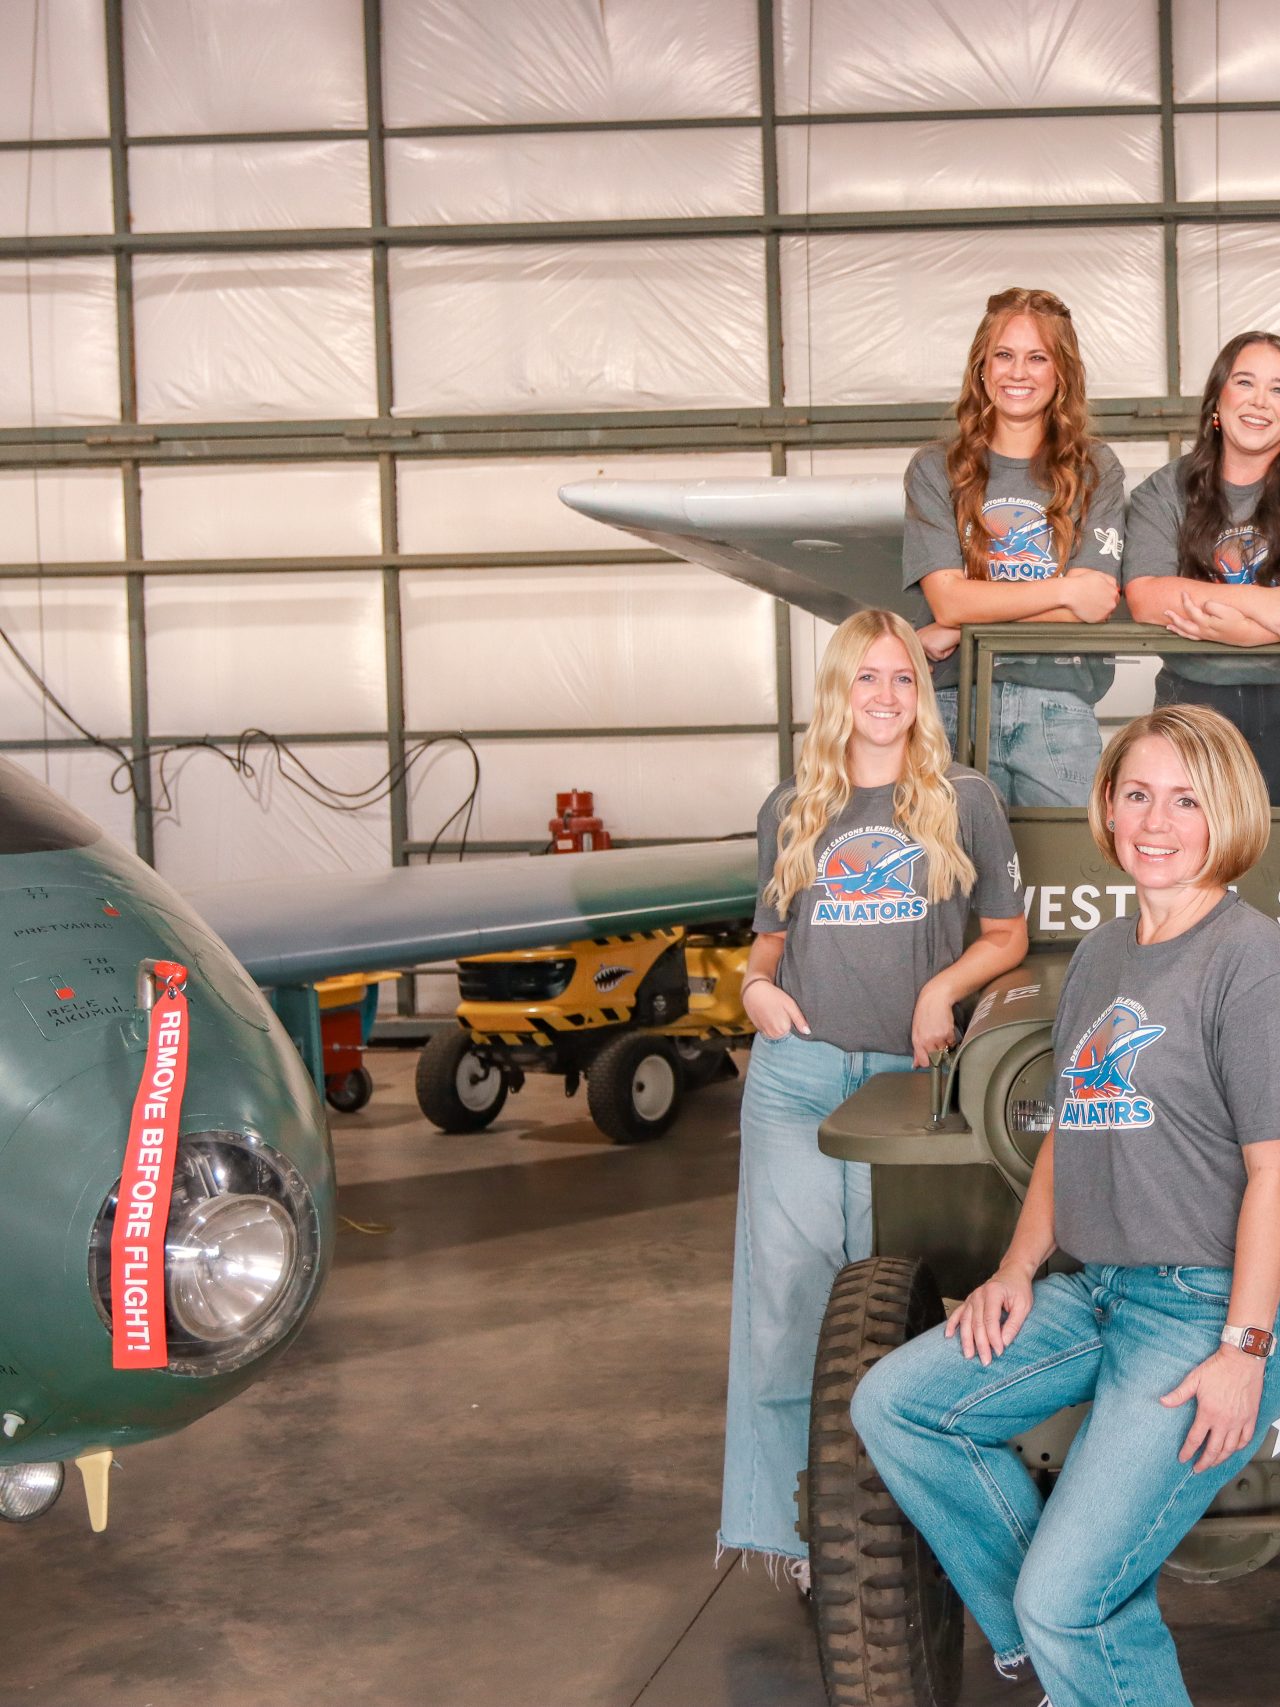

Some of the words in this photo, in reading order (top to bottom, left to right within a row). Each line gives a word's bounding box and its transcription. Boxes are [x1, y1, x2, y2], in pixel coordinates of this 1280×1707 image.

[813, 898, 926, 923] AVIATORS
[144, 1010, 181, 1120] REMOVE
[1060, 1098, 1153, 1127] AVIATORS
[125, 1127, 165, 1238] BEFORE
[123, 1246, 151, 1352] FLIGHT!
